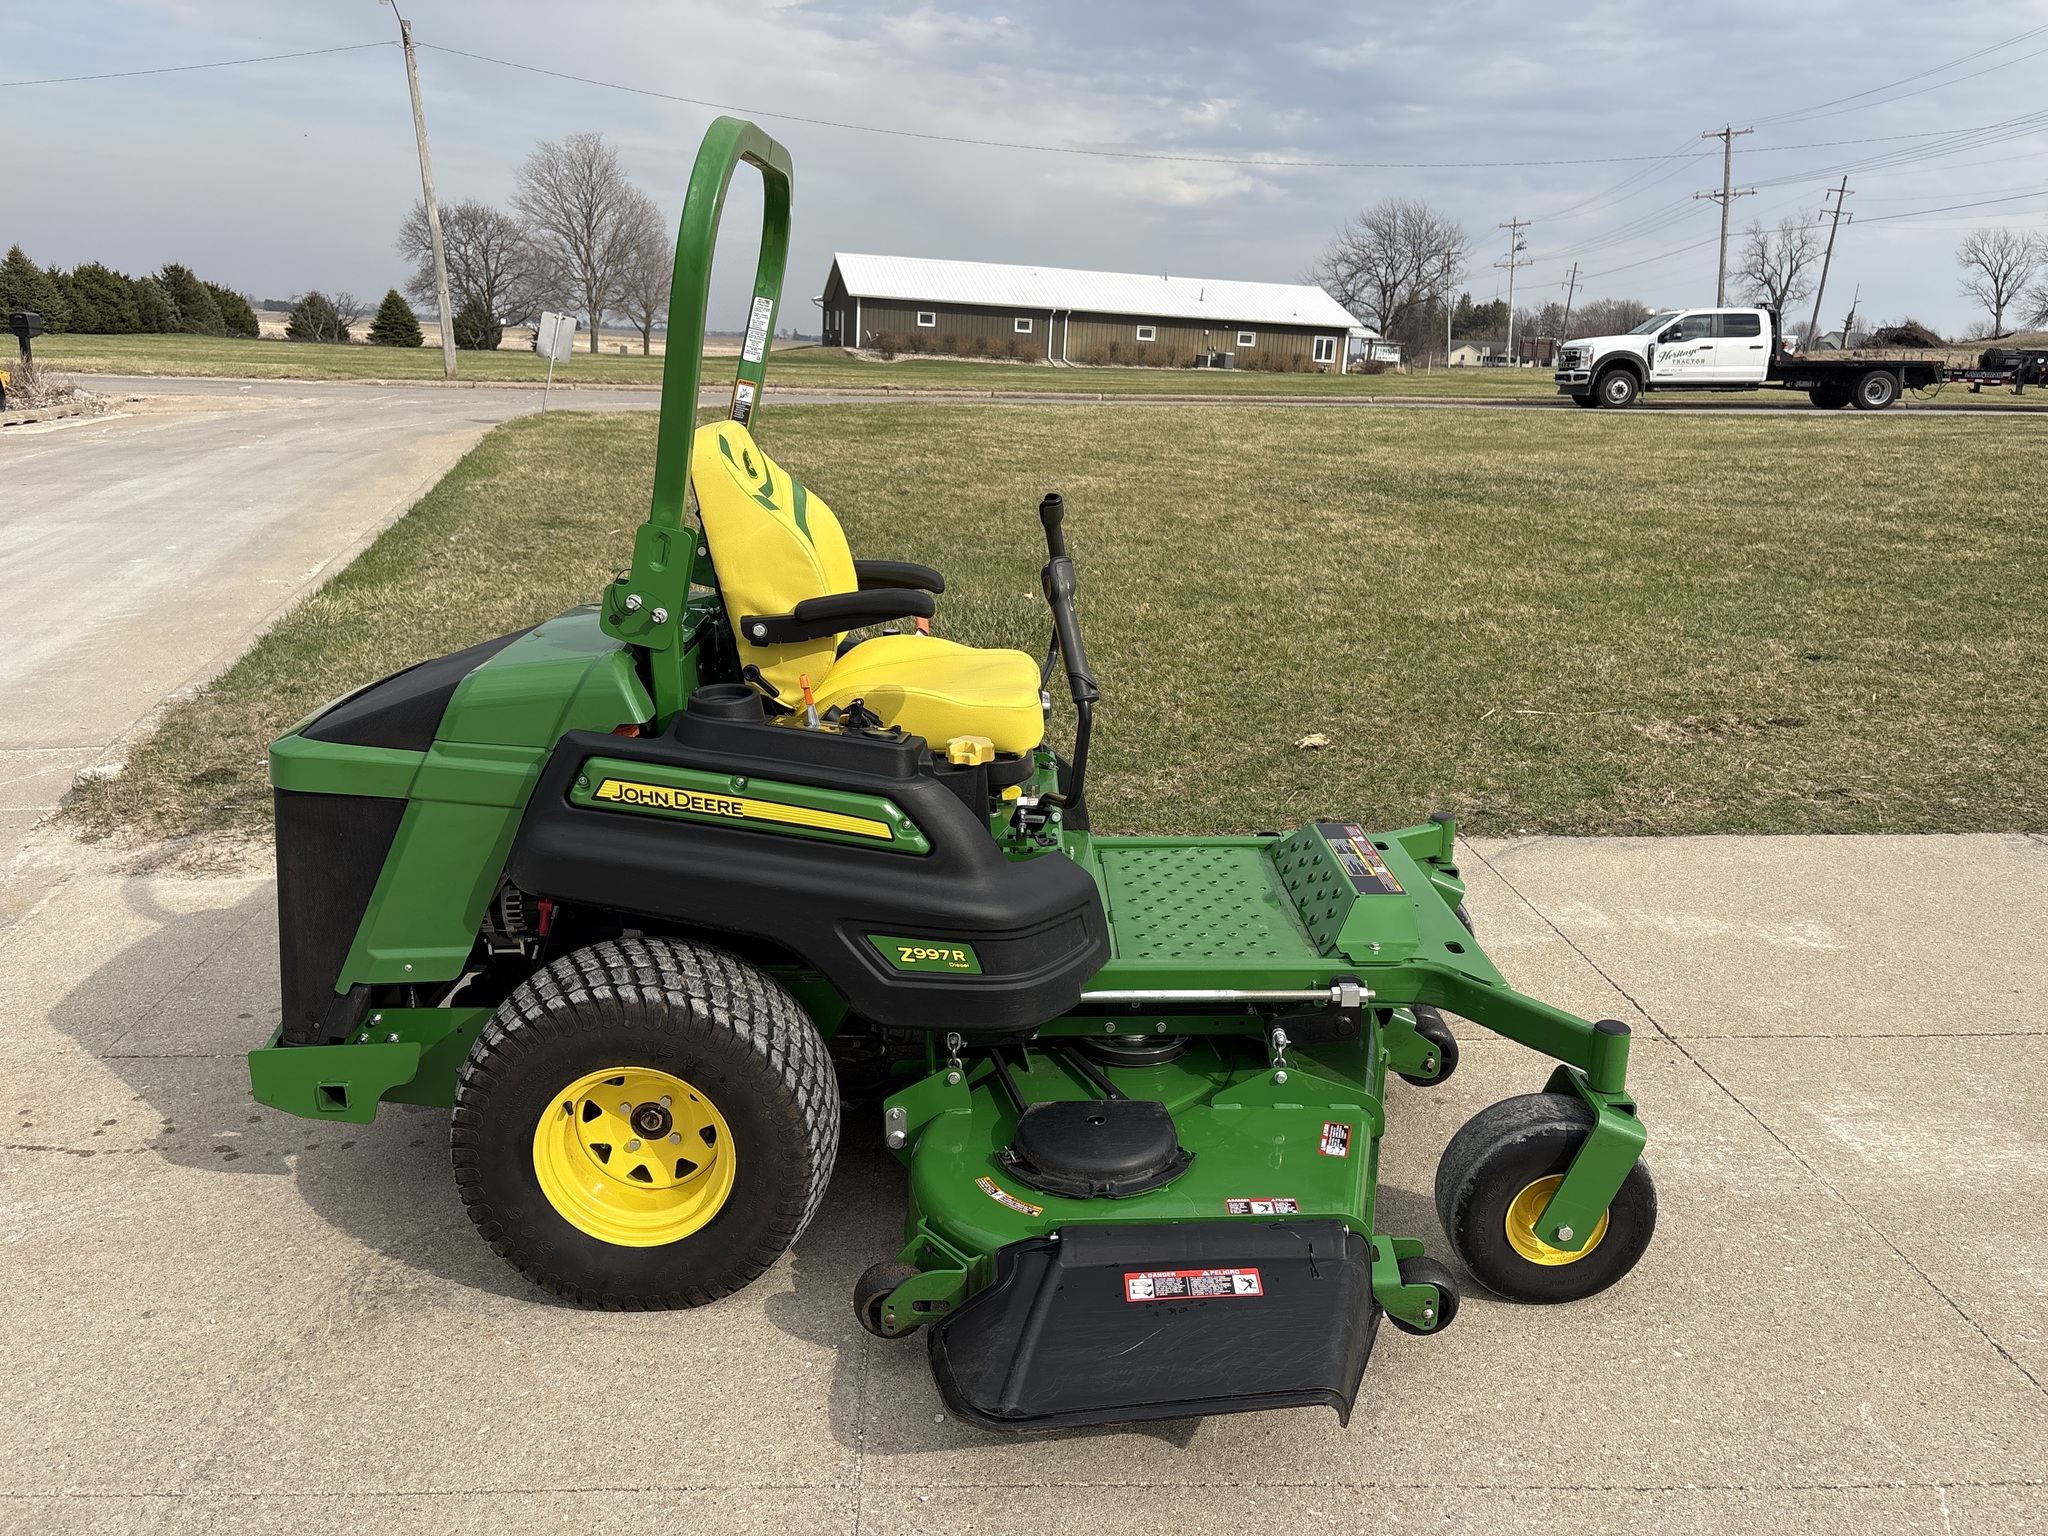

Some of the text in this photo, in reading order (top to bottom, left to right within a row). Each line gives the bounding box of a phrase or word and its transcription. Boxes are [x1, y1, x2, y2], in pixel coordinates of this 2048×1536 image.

[1657, 349, 1700, 363] Heritage
[612, 784, 744, 816] JOHN DEERE
